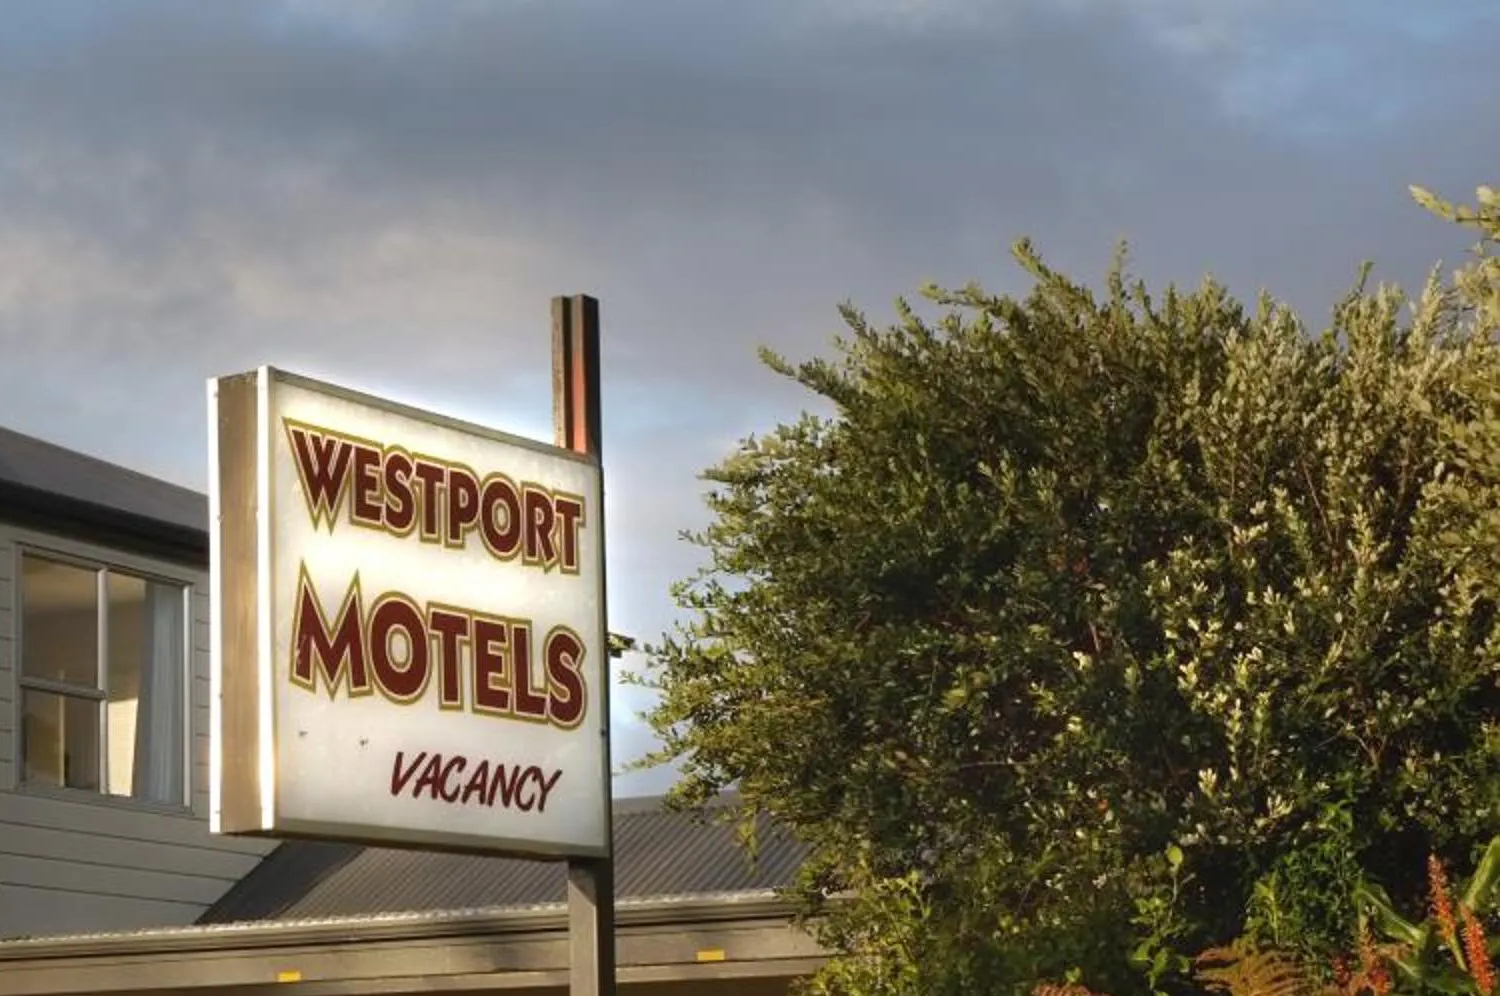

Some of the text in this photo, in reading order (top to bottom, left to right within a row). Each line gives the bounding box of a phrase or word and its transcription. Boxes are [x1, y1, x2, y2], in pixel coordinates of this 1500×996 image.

[283, 417, 585, 575] WESTPORT
[289, 560, 588, 730] MOTELS
[389, 752, 562, 812] VACANCY
